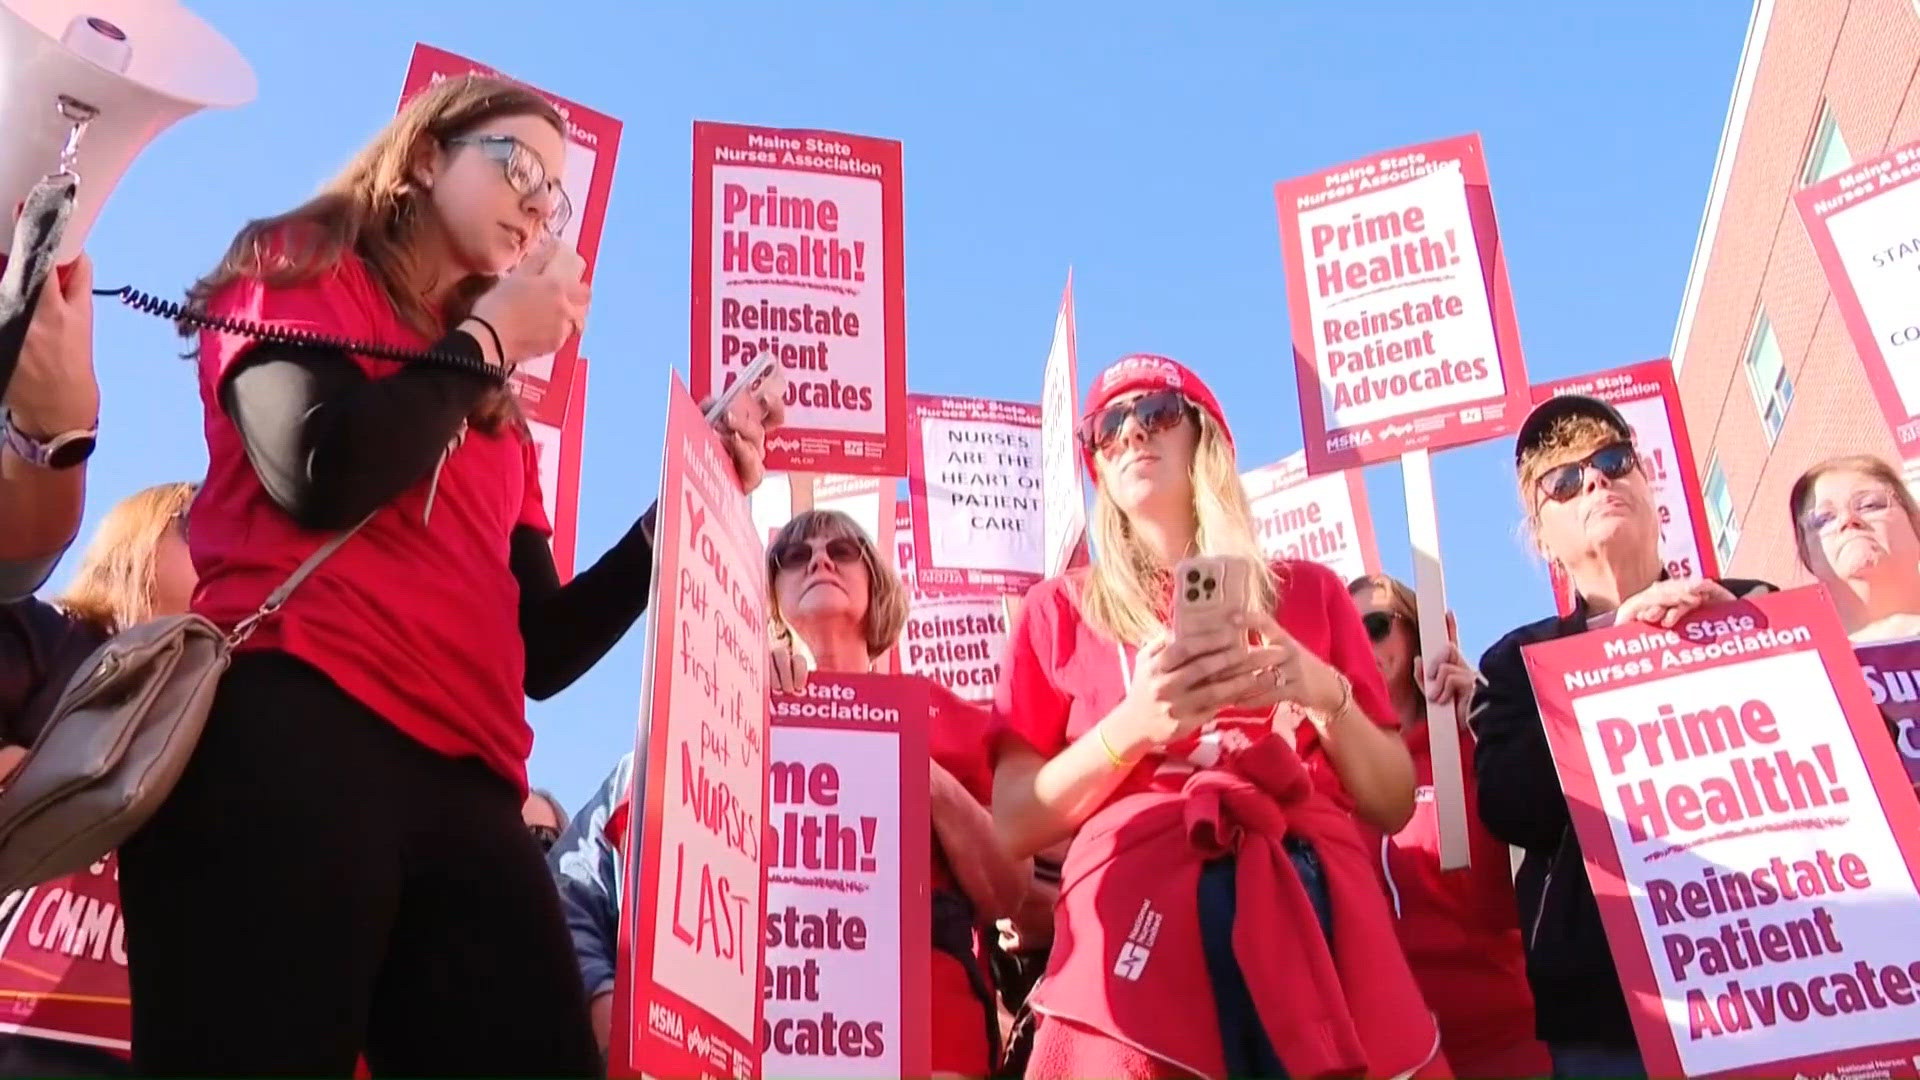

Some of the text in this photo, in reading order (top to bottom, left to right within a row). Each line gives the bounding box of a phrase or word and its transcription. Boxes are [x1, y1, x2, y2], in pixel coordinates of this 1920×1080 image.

[714, 146, 883, 176] Nurses Association
[748, 134, 852, 156] Maine State
[1296, 158, 1462, 209] Nurses Association
[1324, 152, 1426, 188] Maine State
[1838, 158, 1893, 190] Maine
[723, 182, 839, 233] Prime
[1813, 179, 1875, 216] Nurses
[1311, 205, 1426, 259] Prime
[722, 230, 866, 282] Health!
[1316, 228, 1461, 298] Health!
[721, 297, 860, 337] Reinstate
[1322, 294, 1464, 347] Reinstate
[1327, 329, 1437, 378] Patient
[1333, 357, 1490, 413] Advocates
[1553, 374, 1634, 397] Maine State
[916, 406, 968, 419] Nurses
[941, 399, 1028, 415] Maine State
[947, 451, 1034, 468] ARE THE
[948, 430, 1030, 449] NURSES
[1326, 429, 1374, 450] MSNA
[942, 471, 1010, 487] HEART
[951, 494, 1039, 512] PATIENT
[971, 516, 1026, 533] CARE
[906, 612, 1007, 641] Reinstate
[1602, 614, 1756, 660] Maine State
[909, 638, 990, 667] Patient
[1563, 623, 1812, 691] Nurses Association
[1596, 699, 1781, 776] Prime
[1616, 743, 1850, 845] Health!
[1645, 850, 1872, 926] Reinstate
[672, 842, 750, 976] LAST
[1661, 906, 1844, 982] Patient
[649, 999, 684, 1041] MSNA
